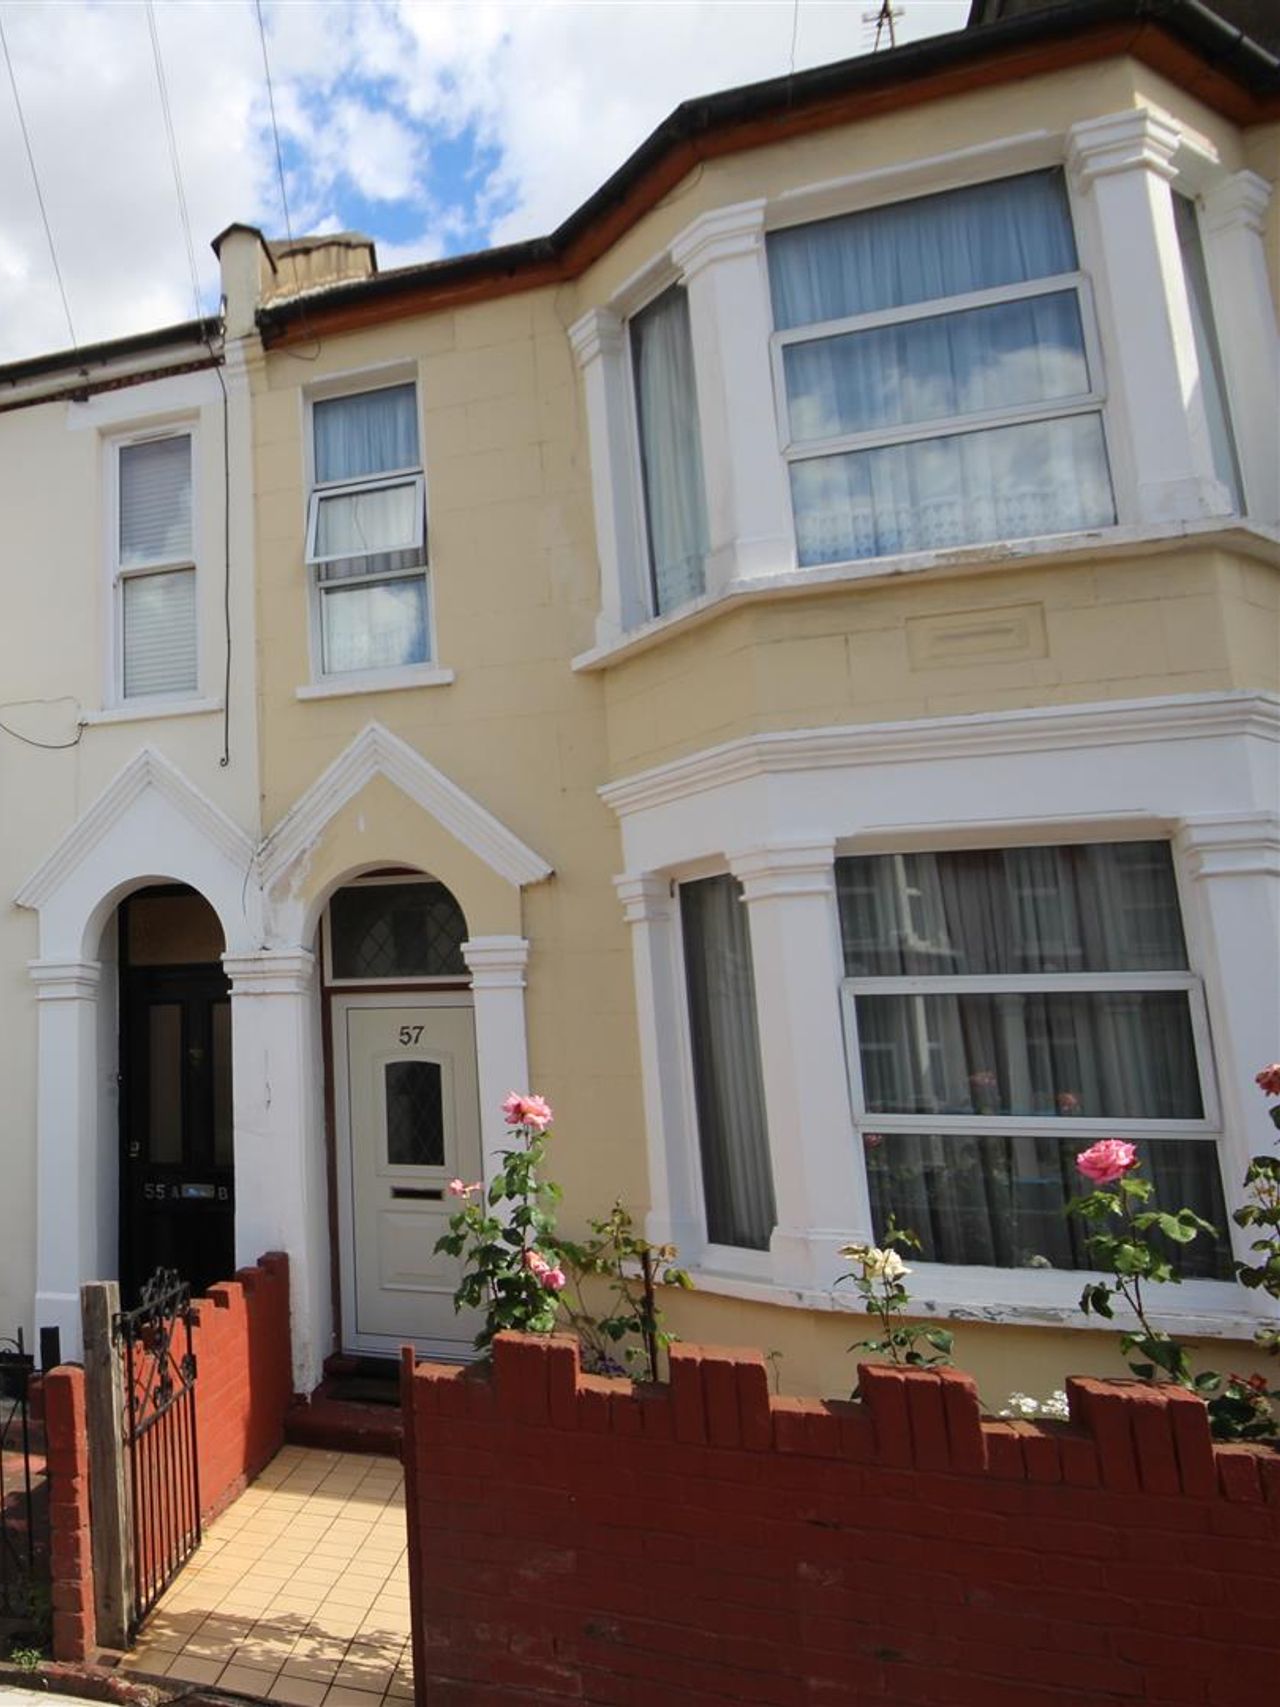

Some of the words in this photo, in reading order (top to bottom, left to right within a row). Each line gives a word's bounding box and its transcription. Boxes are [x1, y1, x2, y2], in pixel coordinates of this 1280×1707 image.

[398, 1025, 425, 1046] 57
[144, 1183, 166, 1200] 55
[218, 1186, 228, 1201] B
